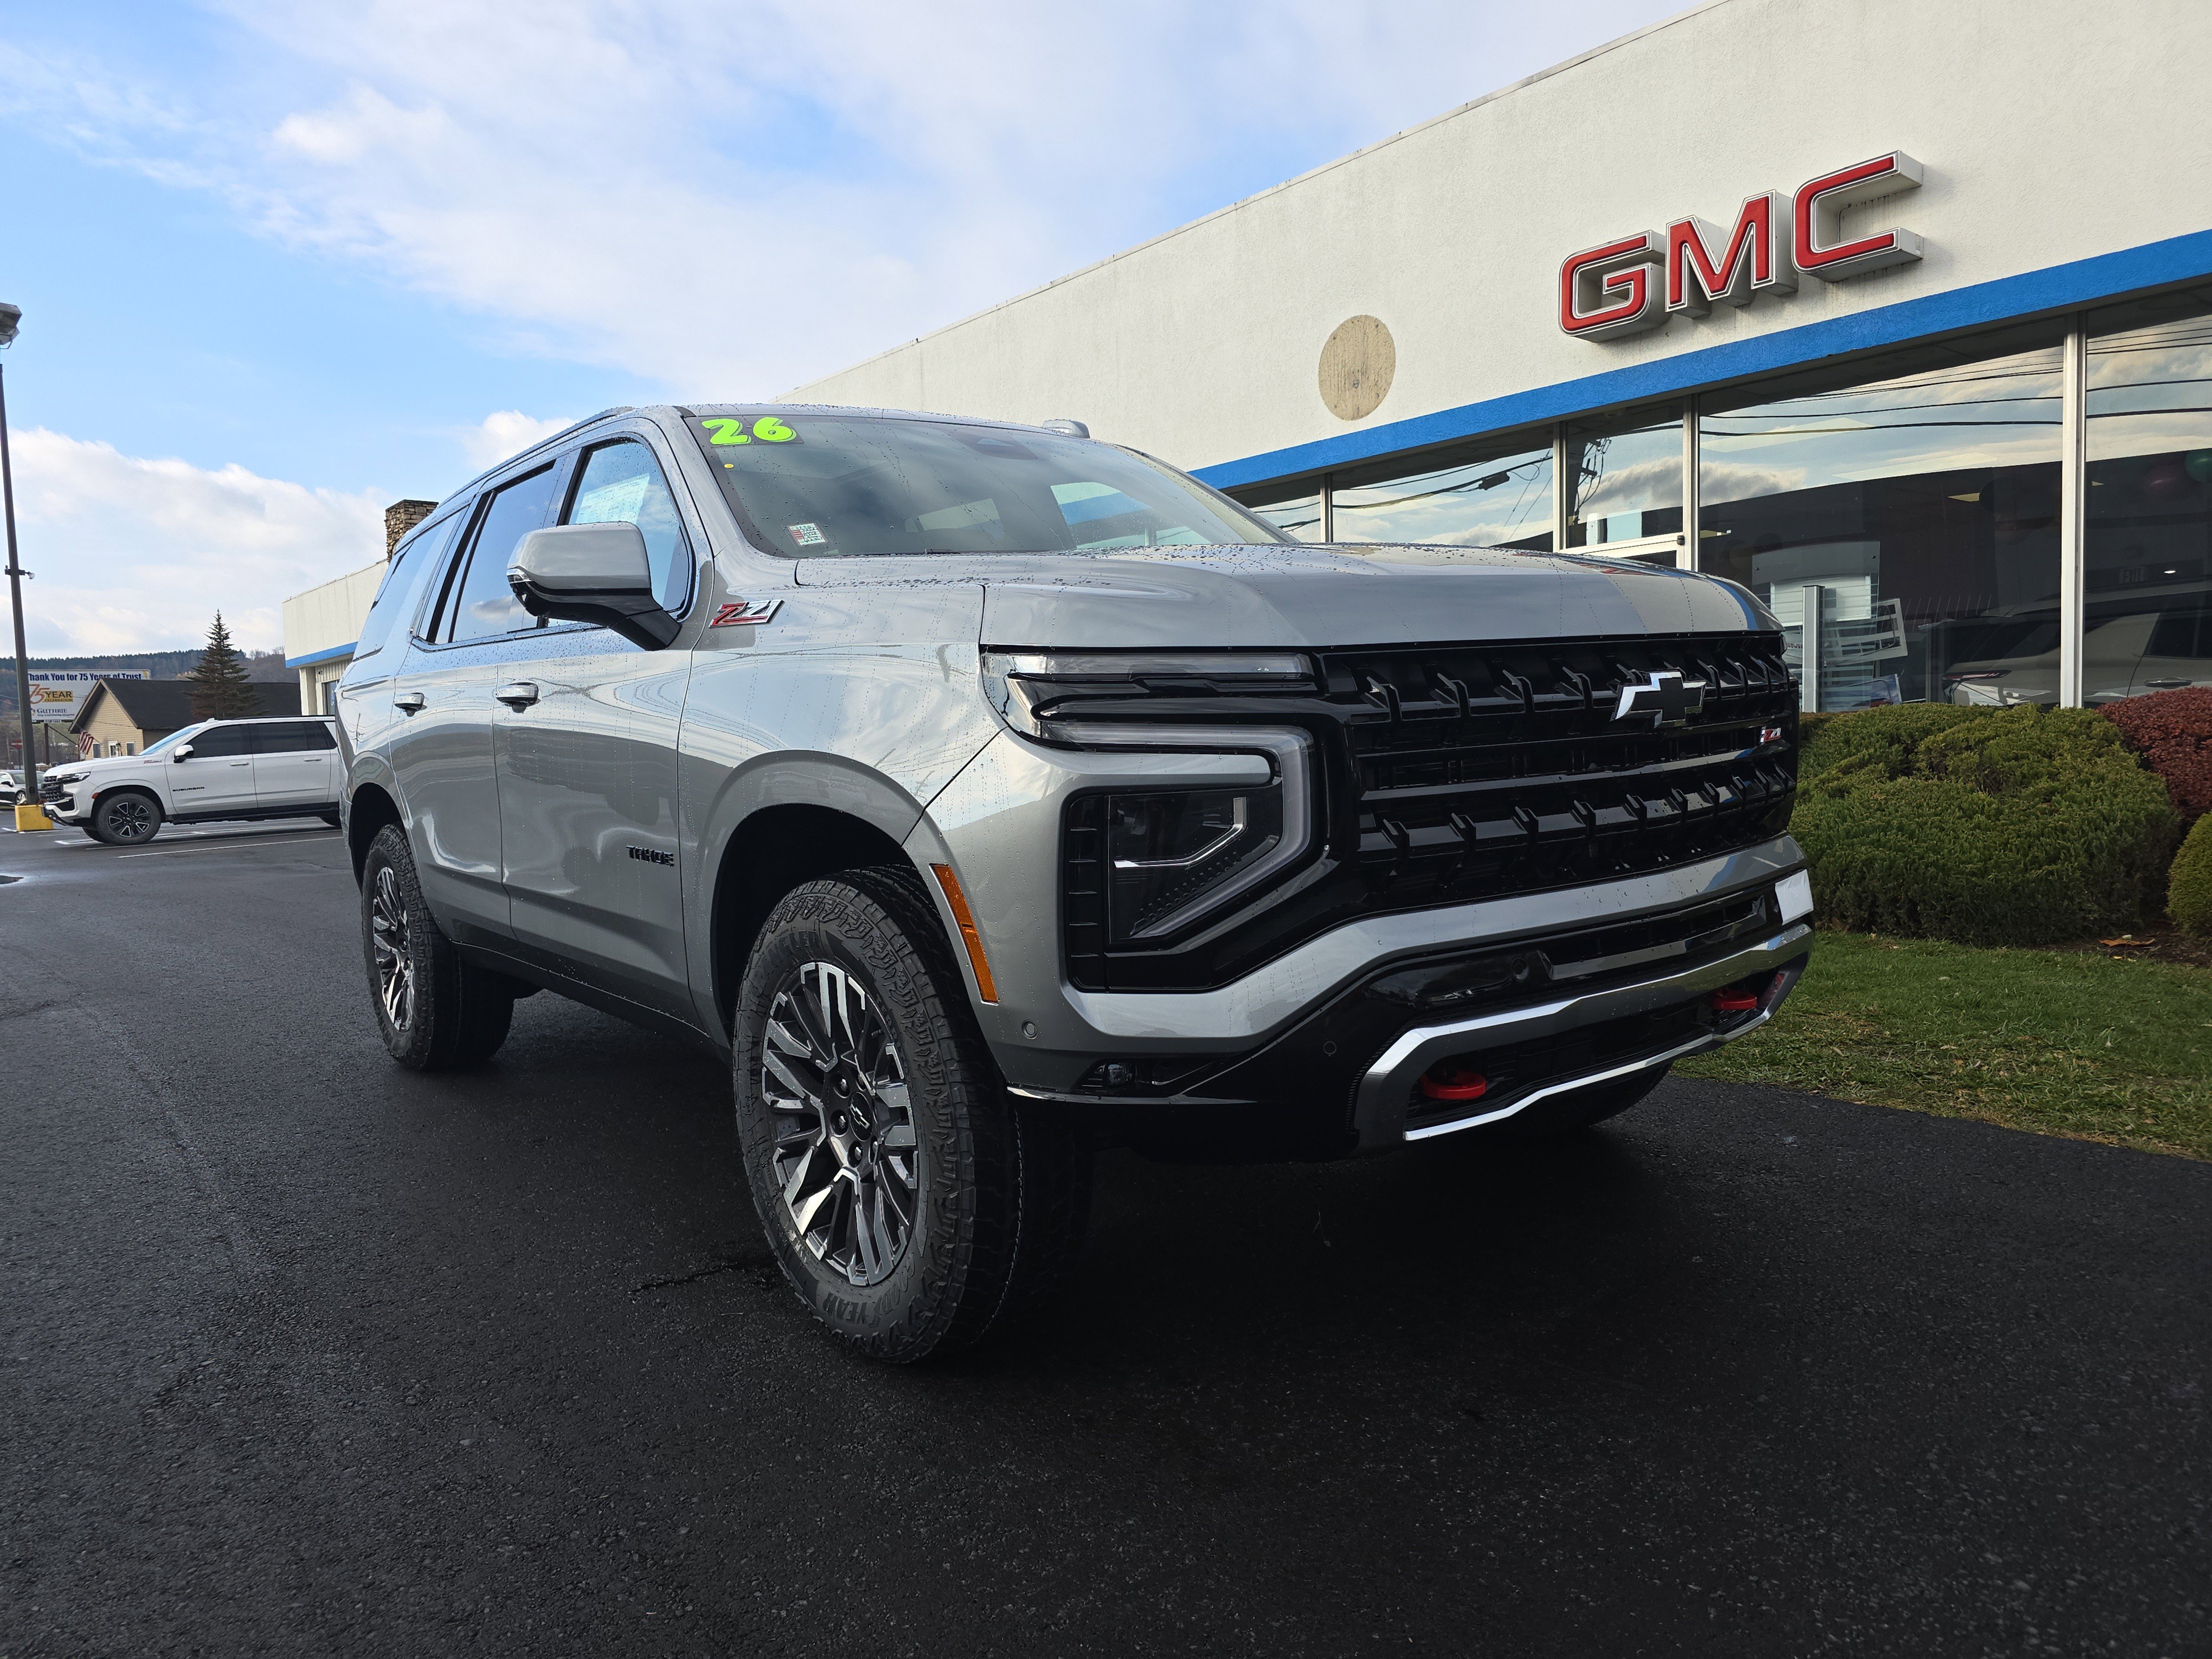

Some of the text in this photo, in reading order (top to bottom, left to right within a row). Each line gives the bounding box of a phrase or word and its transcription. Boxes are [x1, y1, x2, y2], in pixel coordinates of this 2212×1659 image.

[1559, 150, 1919, 342] GMC
[702, 417, 796, 445] 26
[708, 600, 785, 628] Z71
[29, 684, 50, 704] 75
